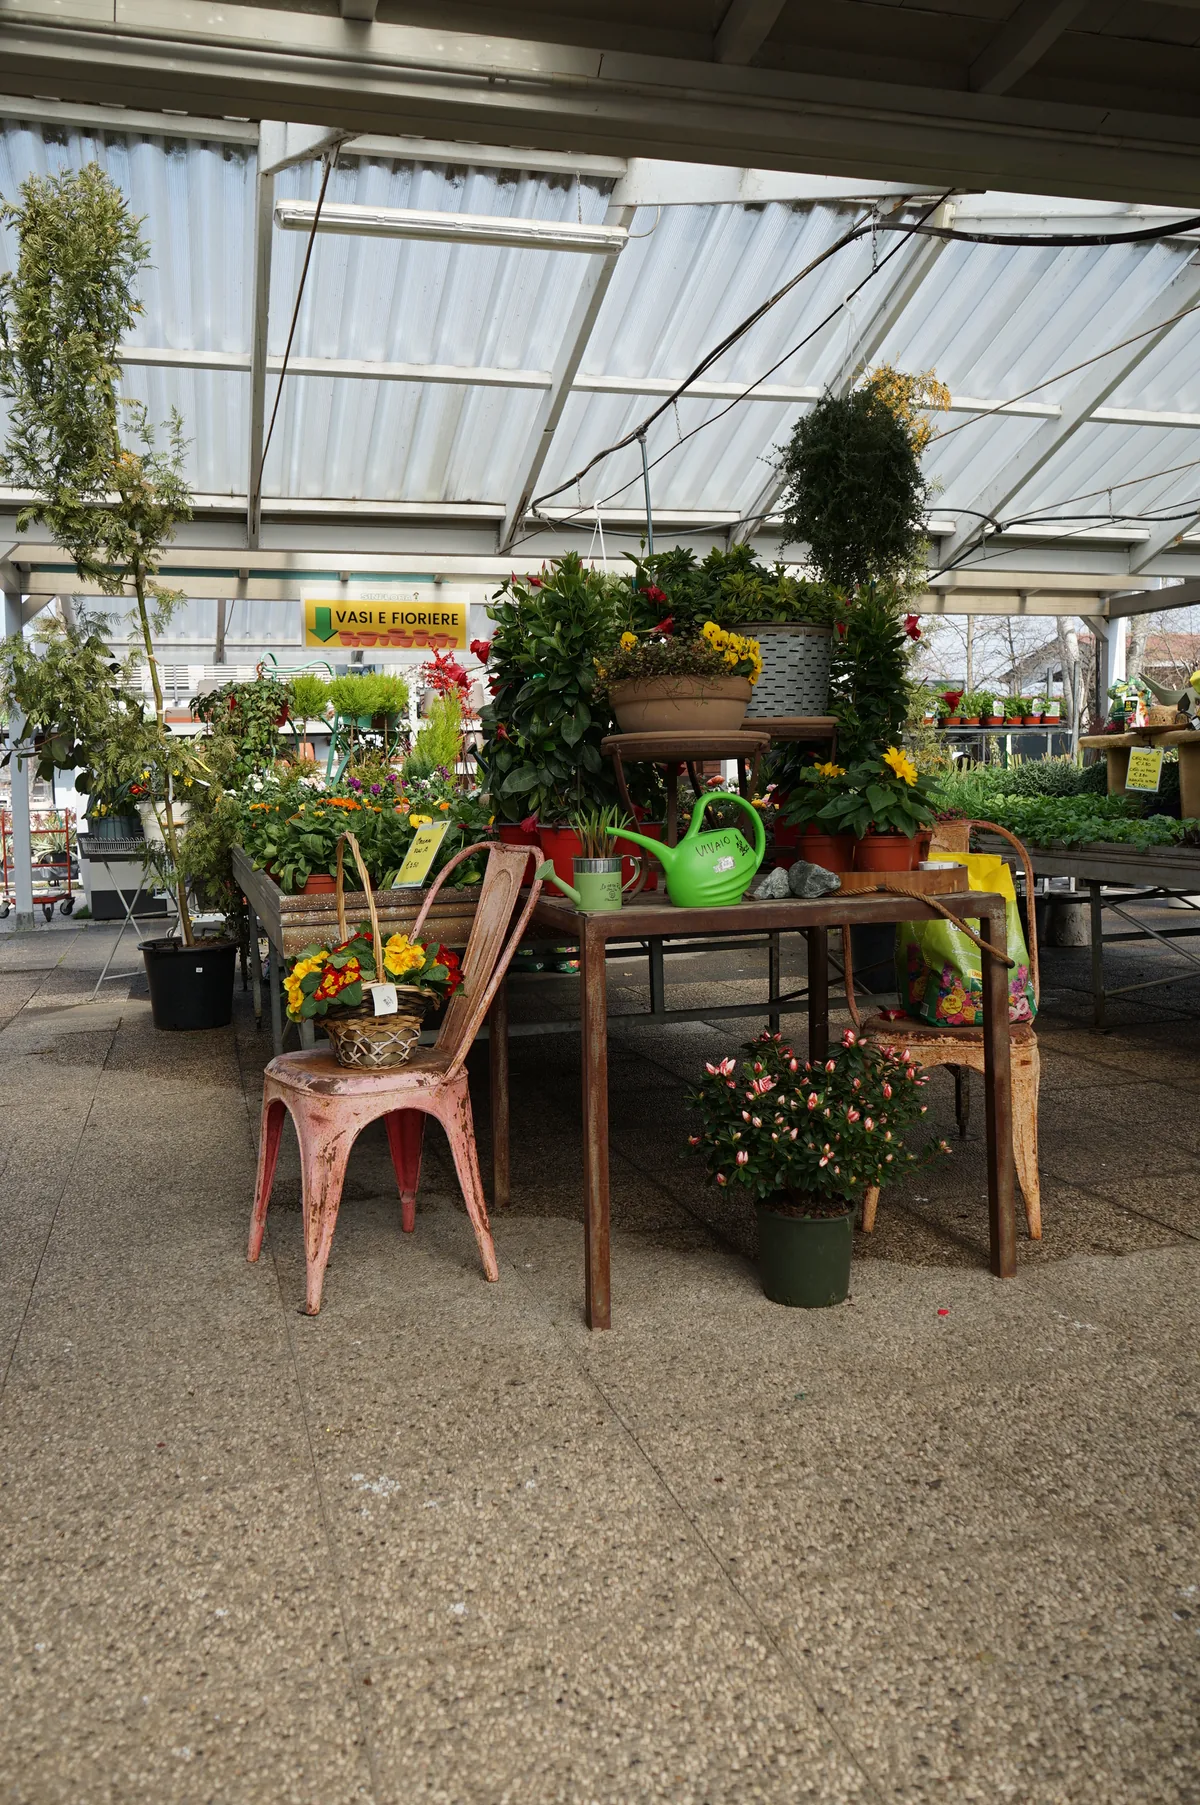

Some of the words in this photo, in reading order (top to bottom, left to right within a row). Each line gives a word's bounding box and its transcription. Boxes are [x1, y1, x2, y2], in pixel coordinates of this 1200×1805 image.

[336, 610, 372, 624] VASI
[378, 611, 386, 624] E
[392, 611, 459, 626] FIORIERE
[695, 836, 731, 857] VIVAIO
